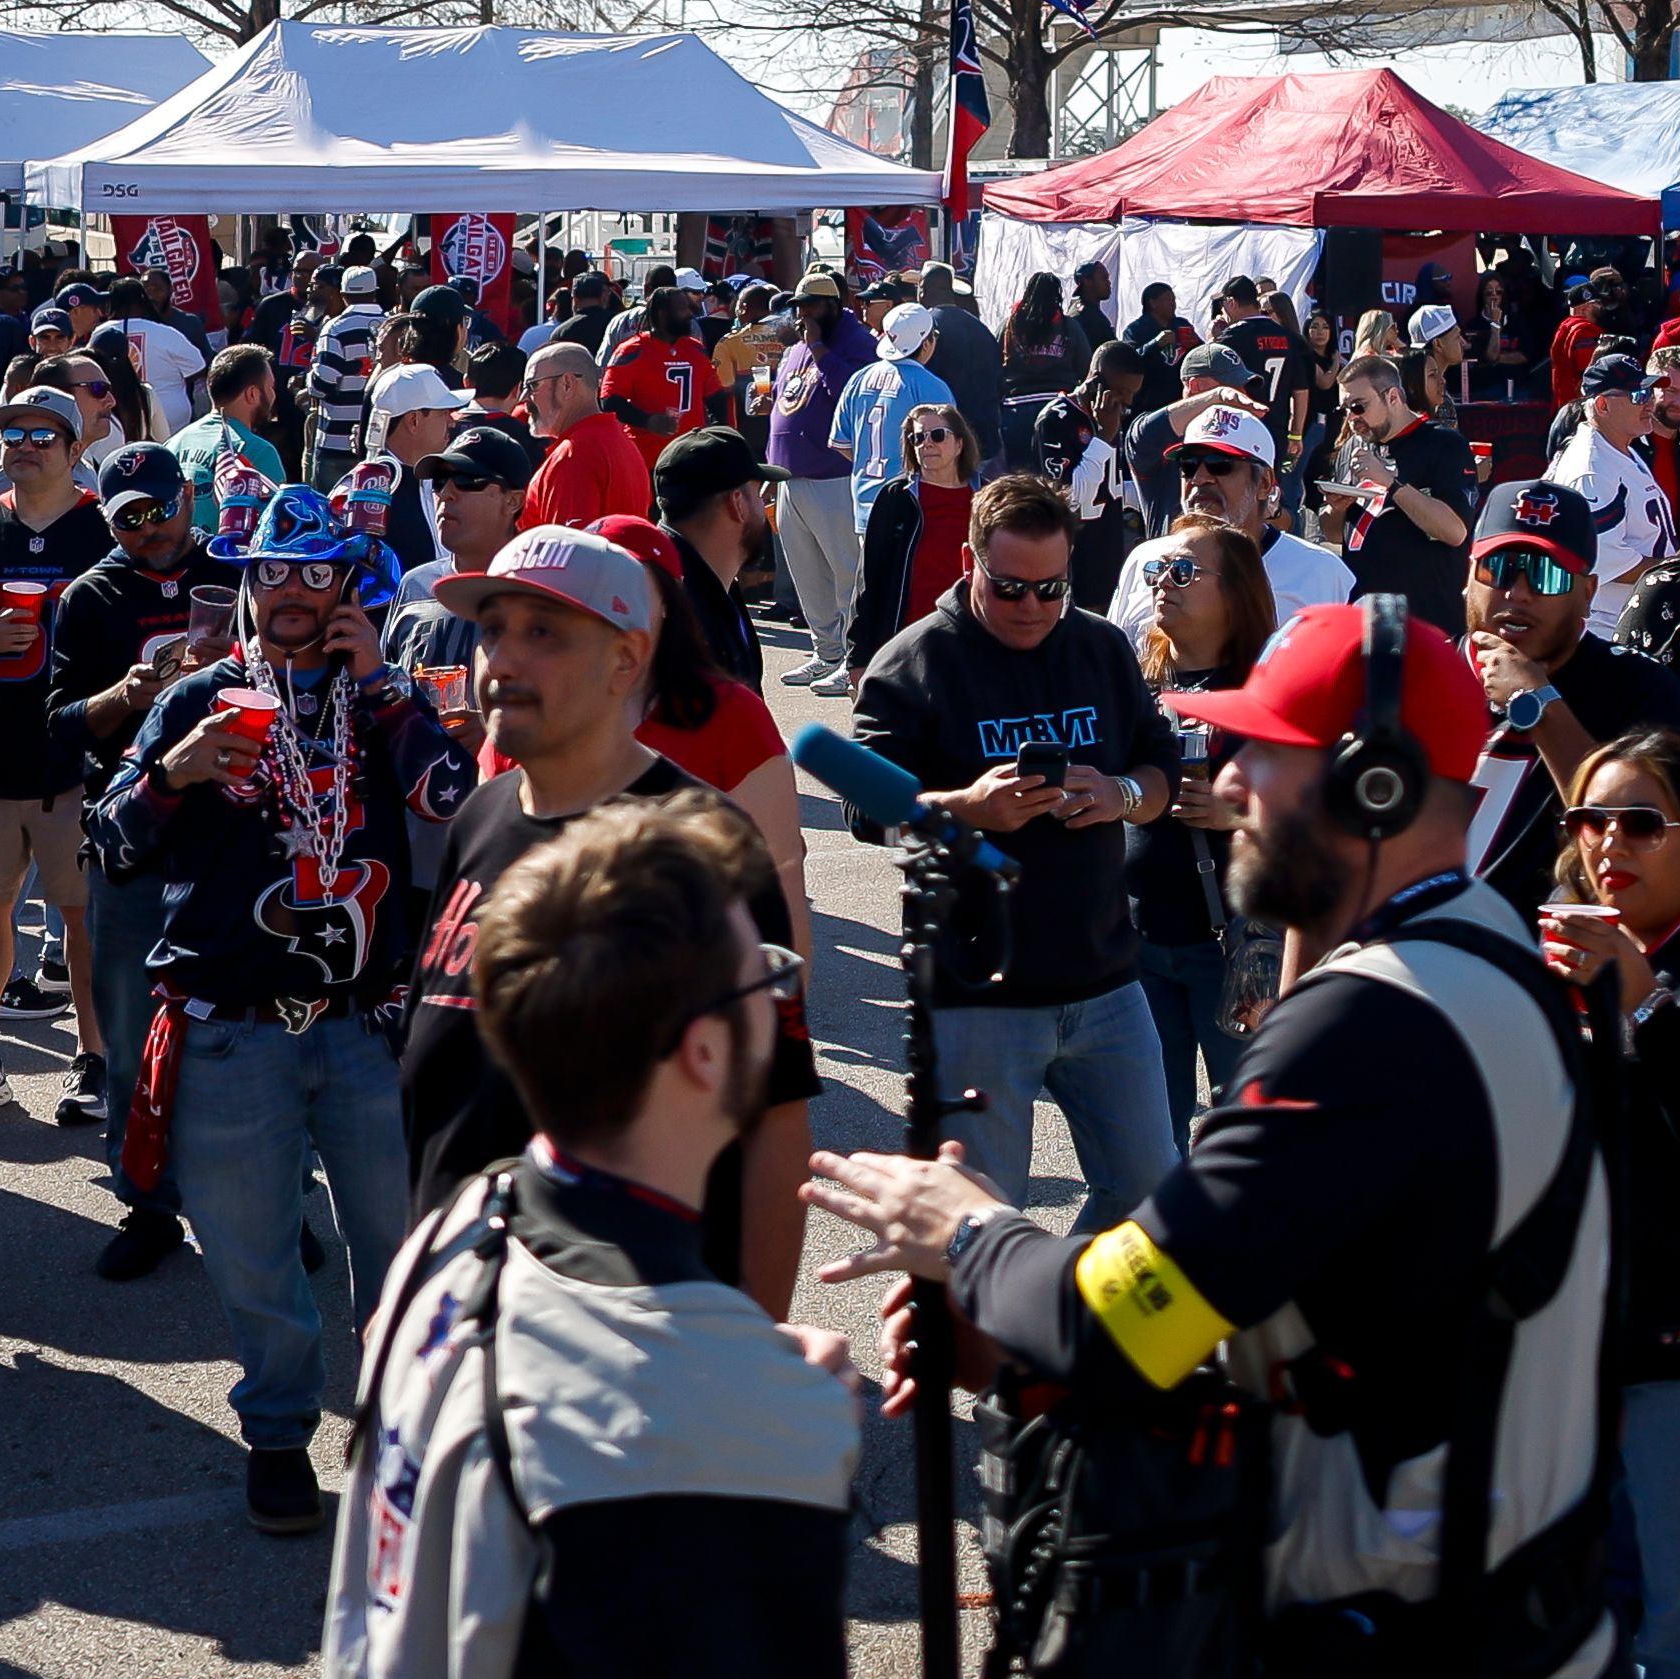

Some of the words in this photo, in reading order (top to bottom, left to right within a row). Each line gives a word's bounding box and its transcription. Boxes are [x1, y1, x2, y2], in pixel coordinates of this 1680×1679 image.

[102, 183, 139, 198] DSG
[153, 213, 195, 306] TAILGATER
[665, 366, 693, 414] 7
[1264, 357, 1287, 402] 7
[866, 405, 889, 480] 1
